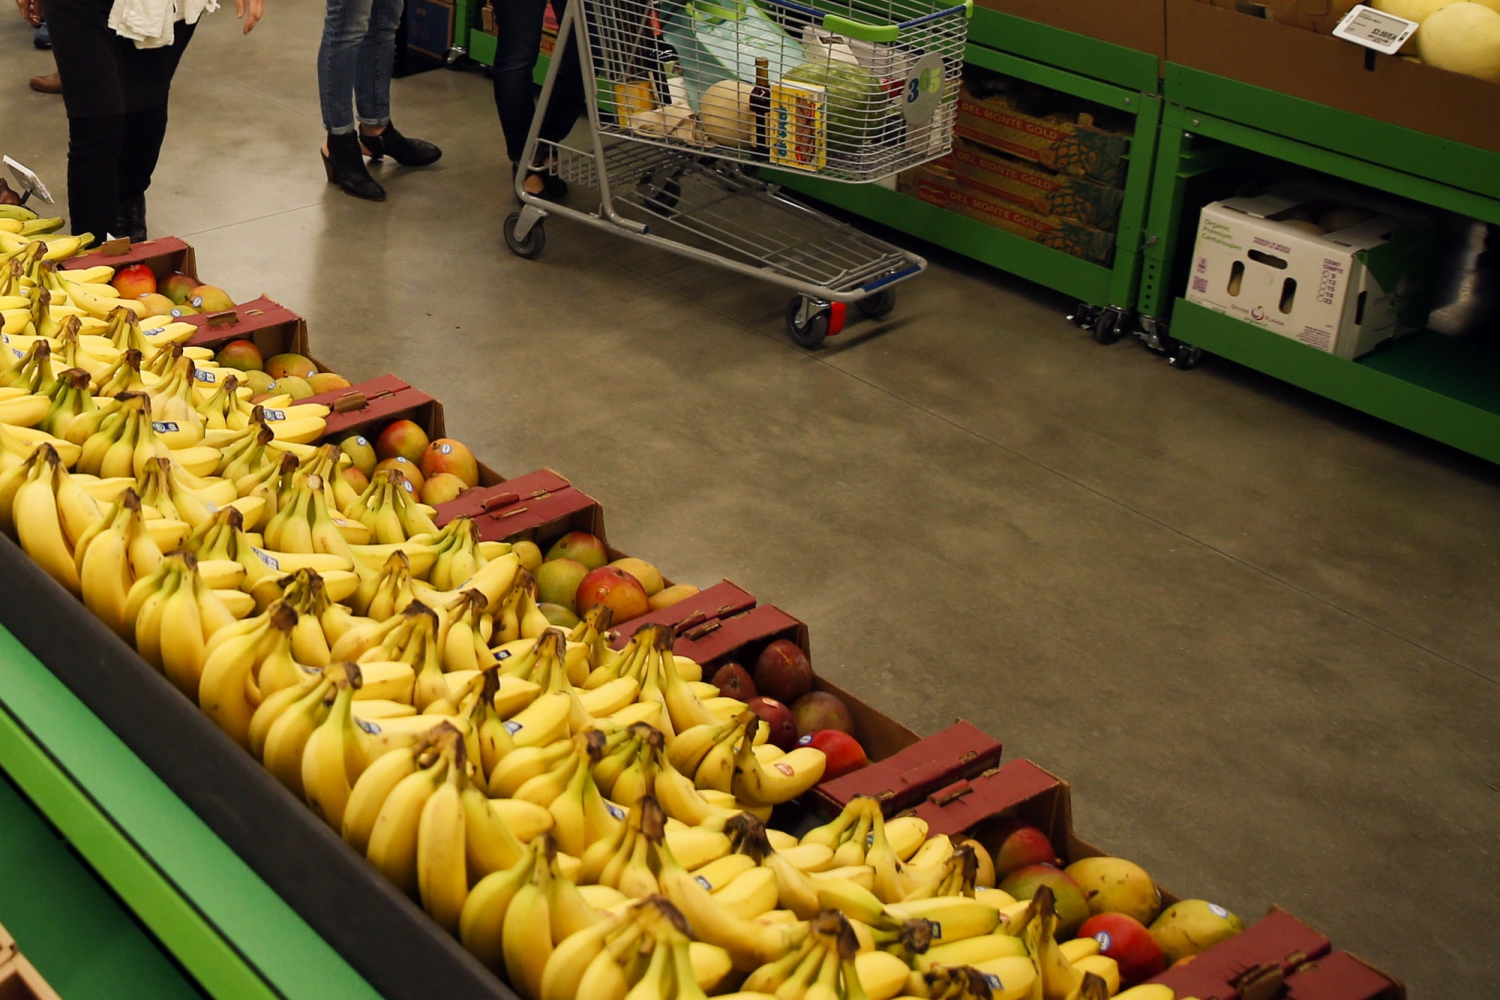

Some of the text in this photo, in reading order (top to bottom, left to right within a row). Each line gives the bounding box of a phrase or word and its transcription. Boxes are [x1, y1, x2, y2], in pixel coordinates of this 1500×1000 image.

[907, 67, 941, 104] 365
[961, 102, 1058, 140] DEL MONTE GOLD
[956, 151, 1051, 190] DEL MONTE GOLD
[949, 190, 969, 204] DEL
[972, 199, 1010, 219] MONTE
[1013, 213, 1044, 231] GOLD
[1202, 225, 1233, 240] Premium
[1203, 218, 1230, 232] Organic
[1201, 232, 1243, 251] Cantaloupes
[1323, 258, 1342, 267] COUNT
[1326, 285, 1336, 293] 15
[1328, 279, 1337, 287] 12
[1325, 291, 1335, 299] 18
